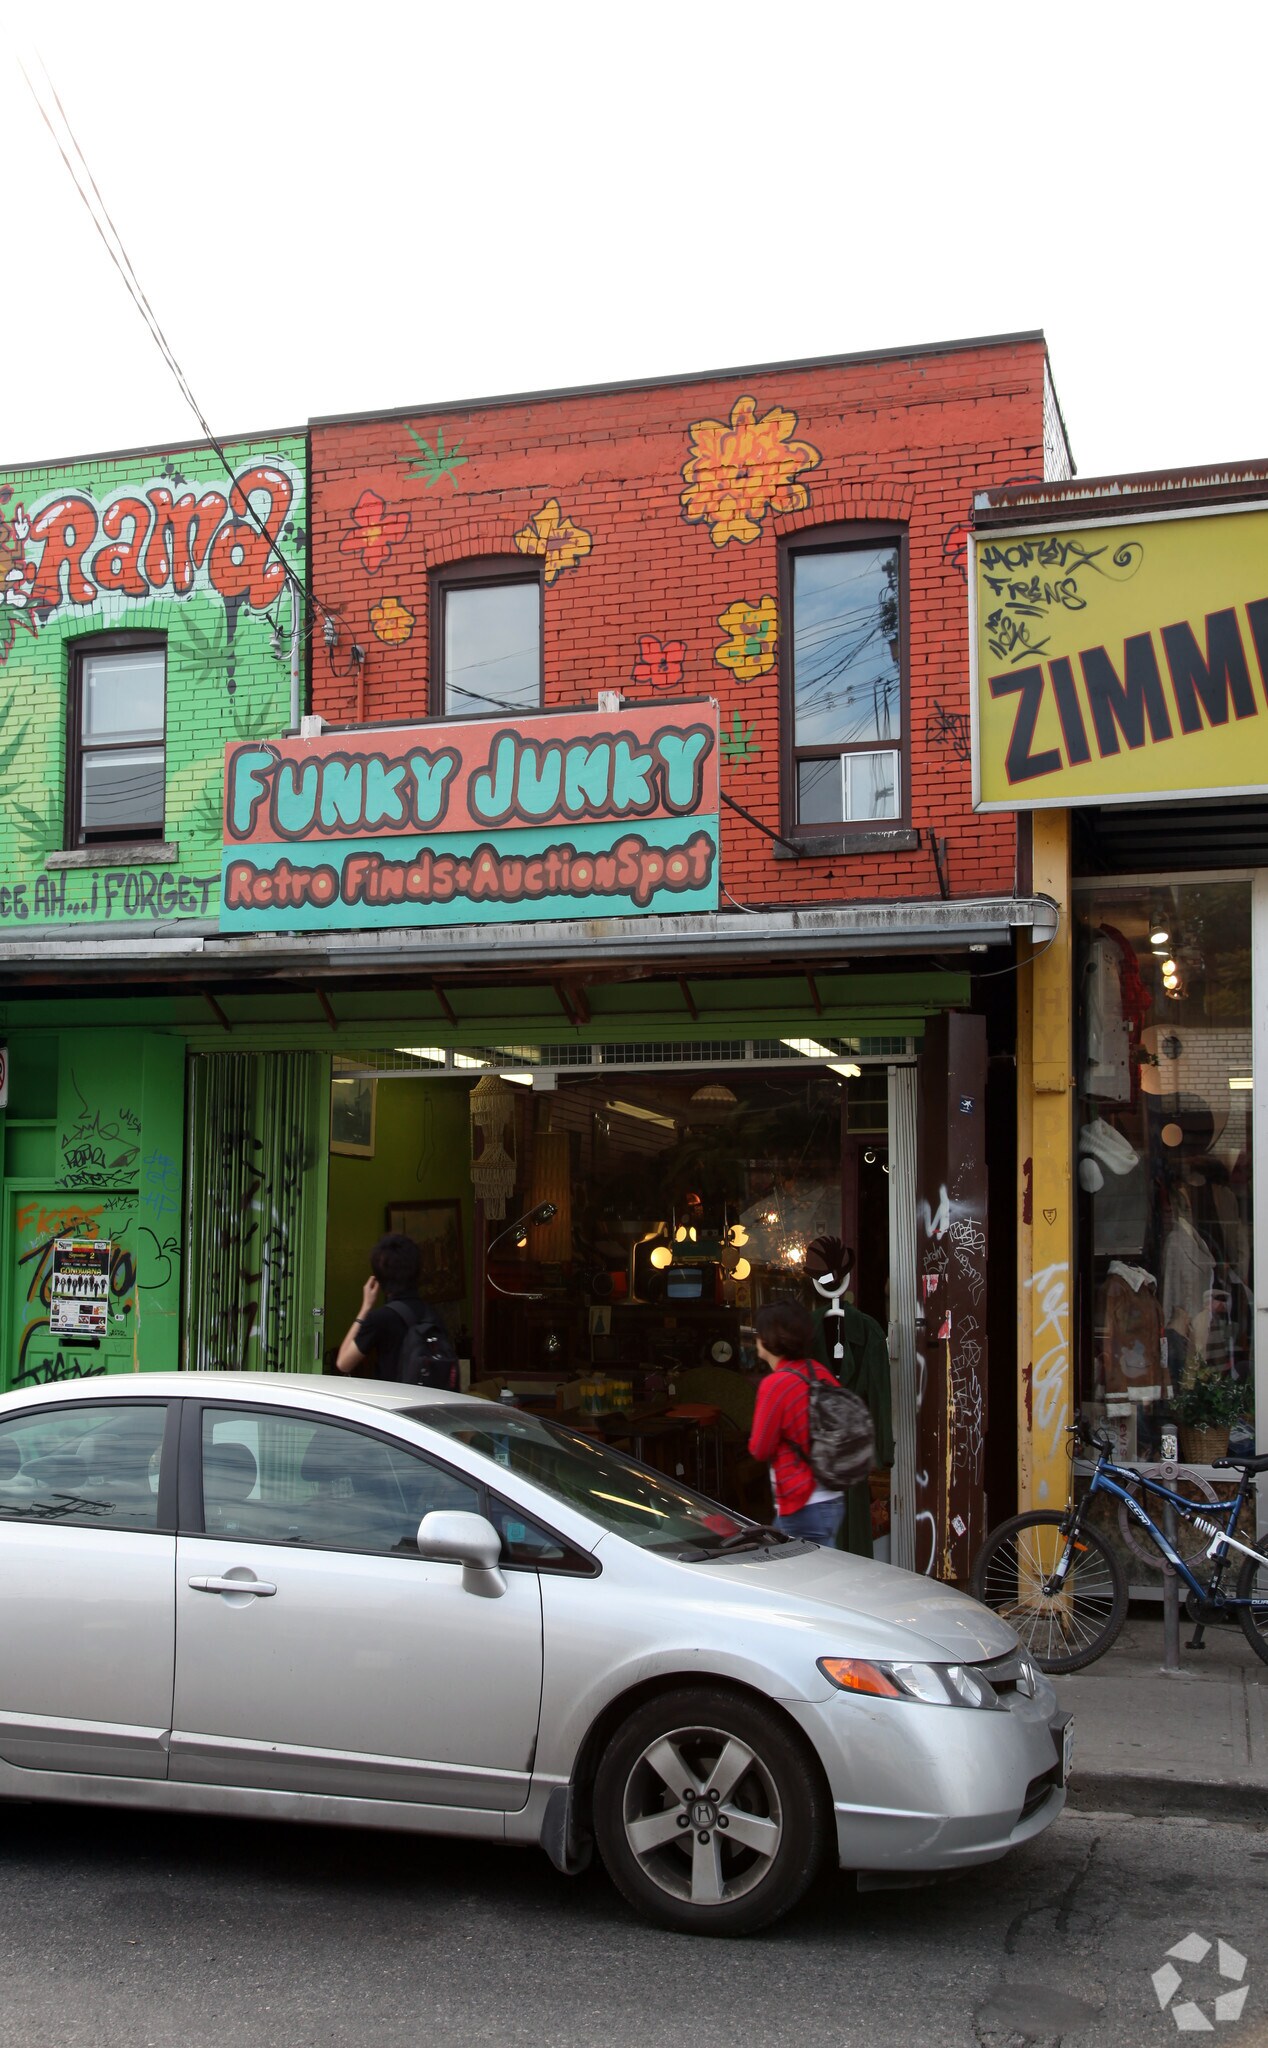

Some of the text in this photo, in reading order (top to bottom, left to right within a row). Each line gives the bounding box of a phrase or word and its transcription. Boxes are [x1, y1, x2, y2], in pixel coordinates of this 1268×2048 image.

[226, 722, 714, 841] FUNKY JUNKY
[226, 857, 339, 910] Retro
[1126, 1500, 1148, 1524] CCM
